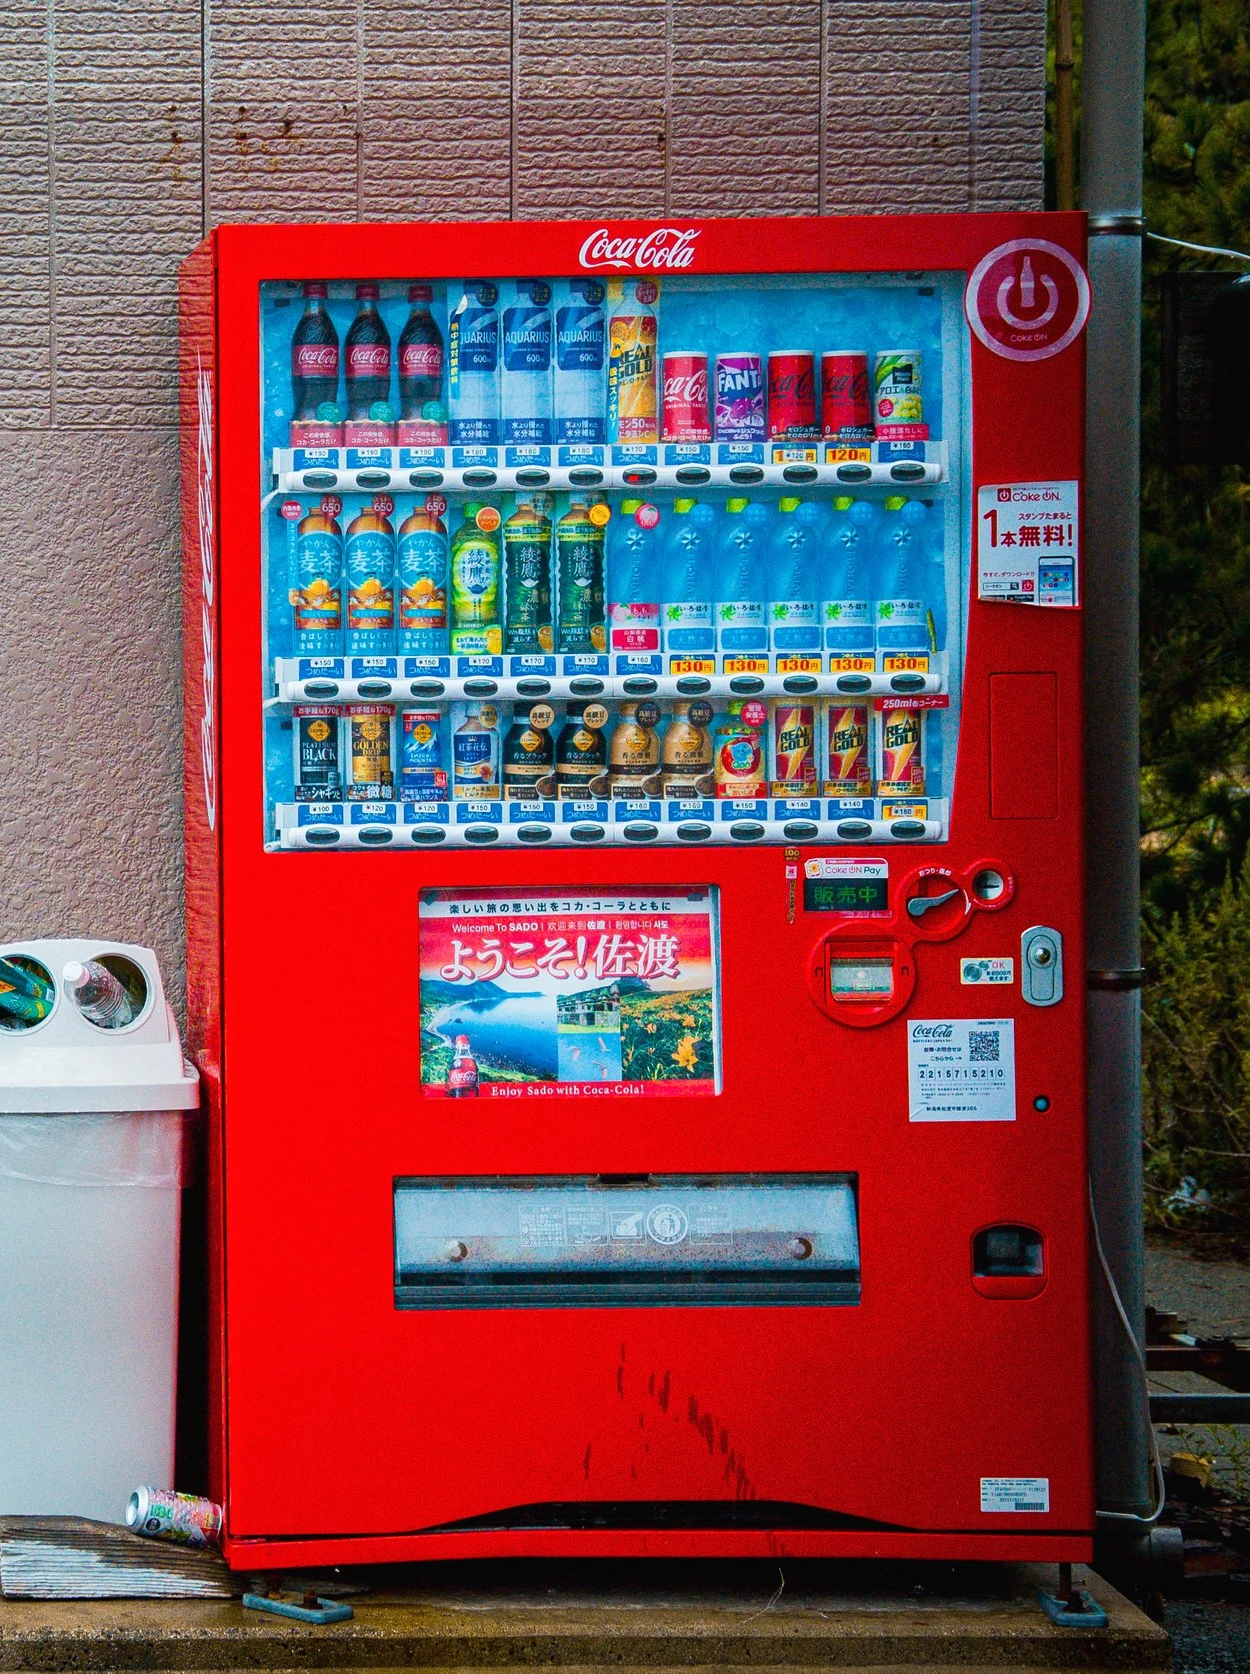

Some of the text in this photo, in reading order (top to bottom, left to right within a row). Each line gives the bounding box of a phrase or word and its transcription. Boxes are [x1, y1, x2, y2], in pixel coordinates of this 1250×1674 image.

[578, 228, 702, 268] Coca-Cola
[505, 331, 549, 343] AQUARIUS
[558, 331, 603, 343] AQUARIUS
[1010, 334, 1032, 342] Coke
[299, 348, 337, 364] Coca-Cola
[351, 348, 388, 364] Coca-Cola
[404, 348, 441, 364] Coca-Cola
[830, 450, 867, 460] 120円
[1012, 492, 1040, 502] Coke
[322, 502, 340, 513] 650
[374, 502, 392, 512] 650
[426, 501, 445, 512] 650
[1018, 512, 1072, 520] スタンプたまると
[300, 549, 340, 573] 麦茶
[350, 549, 393, 573] 麦茶
[402, 549, 445, 573] 麦茶
[468, 549, 486, 582] 綾鷹
[520, 546, 537, 578] 綾鷹
[573, 546, 590, 578] 綾鷹
[632, 607, 647, 615] もも
[627, 635, 645, 643] 白桃
[674, 661, 711, 672] 130円
[728, 660, 765, 671] 130円
[781, 660, 818, 671] 130円
[834, 659, 872, 670] 130円
[888, 658, 925, 670] 130円
[351, 704, 392, 714] お手軽な170g
[883, 698, 944, 708] 250ml缶コーナー
[298, 705, 339, 715] お手軽な170g
[780, 725, 808, 742] REAL
[834, 724, 863, 742] REAL
[886, 720, 918, 736] REAL
[354, 740, 388, 750] GOLDEN
[781, 738, 810, 752] GOLD
[834, 737, 864, 752] GOLD
[886, 731, 918, 748] GOLD
[458, 742, 487, 752] 紅茶花伝
[302, 748, 336, 760] BLACK
[367, 786, 392, 799] 微糖
[849, 866, 862, 874] ON
[864, 867, 881, 875] Pay
[814, 886, 877, 904] 販売中
[449, 901, 671, 914] 楽しい旅の思い出をコカ・コーラとともに
[452, 922, 538, 933] Welcome To SADO
[615, 921, 668, 929] 환영합니다 사도
[440, 934, 681, 980] ようこそ!佐渡
[913, 1024, 954, 1038] Coca-Cola
[920, 1069, 1004, 1079] 2215715210
[491, 1084, 645, 1097] Enjoy Sado with Coca-Cola!
